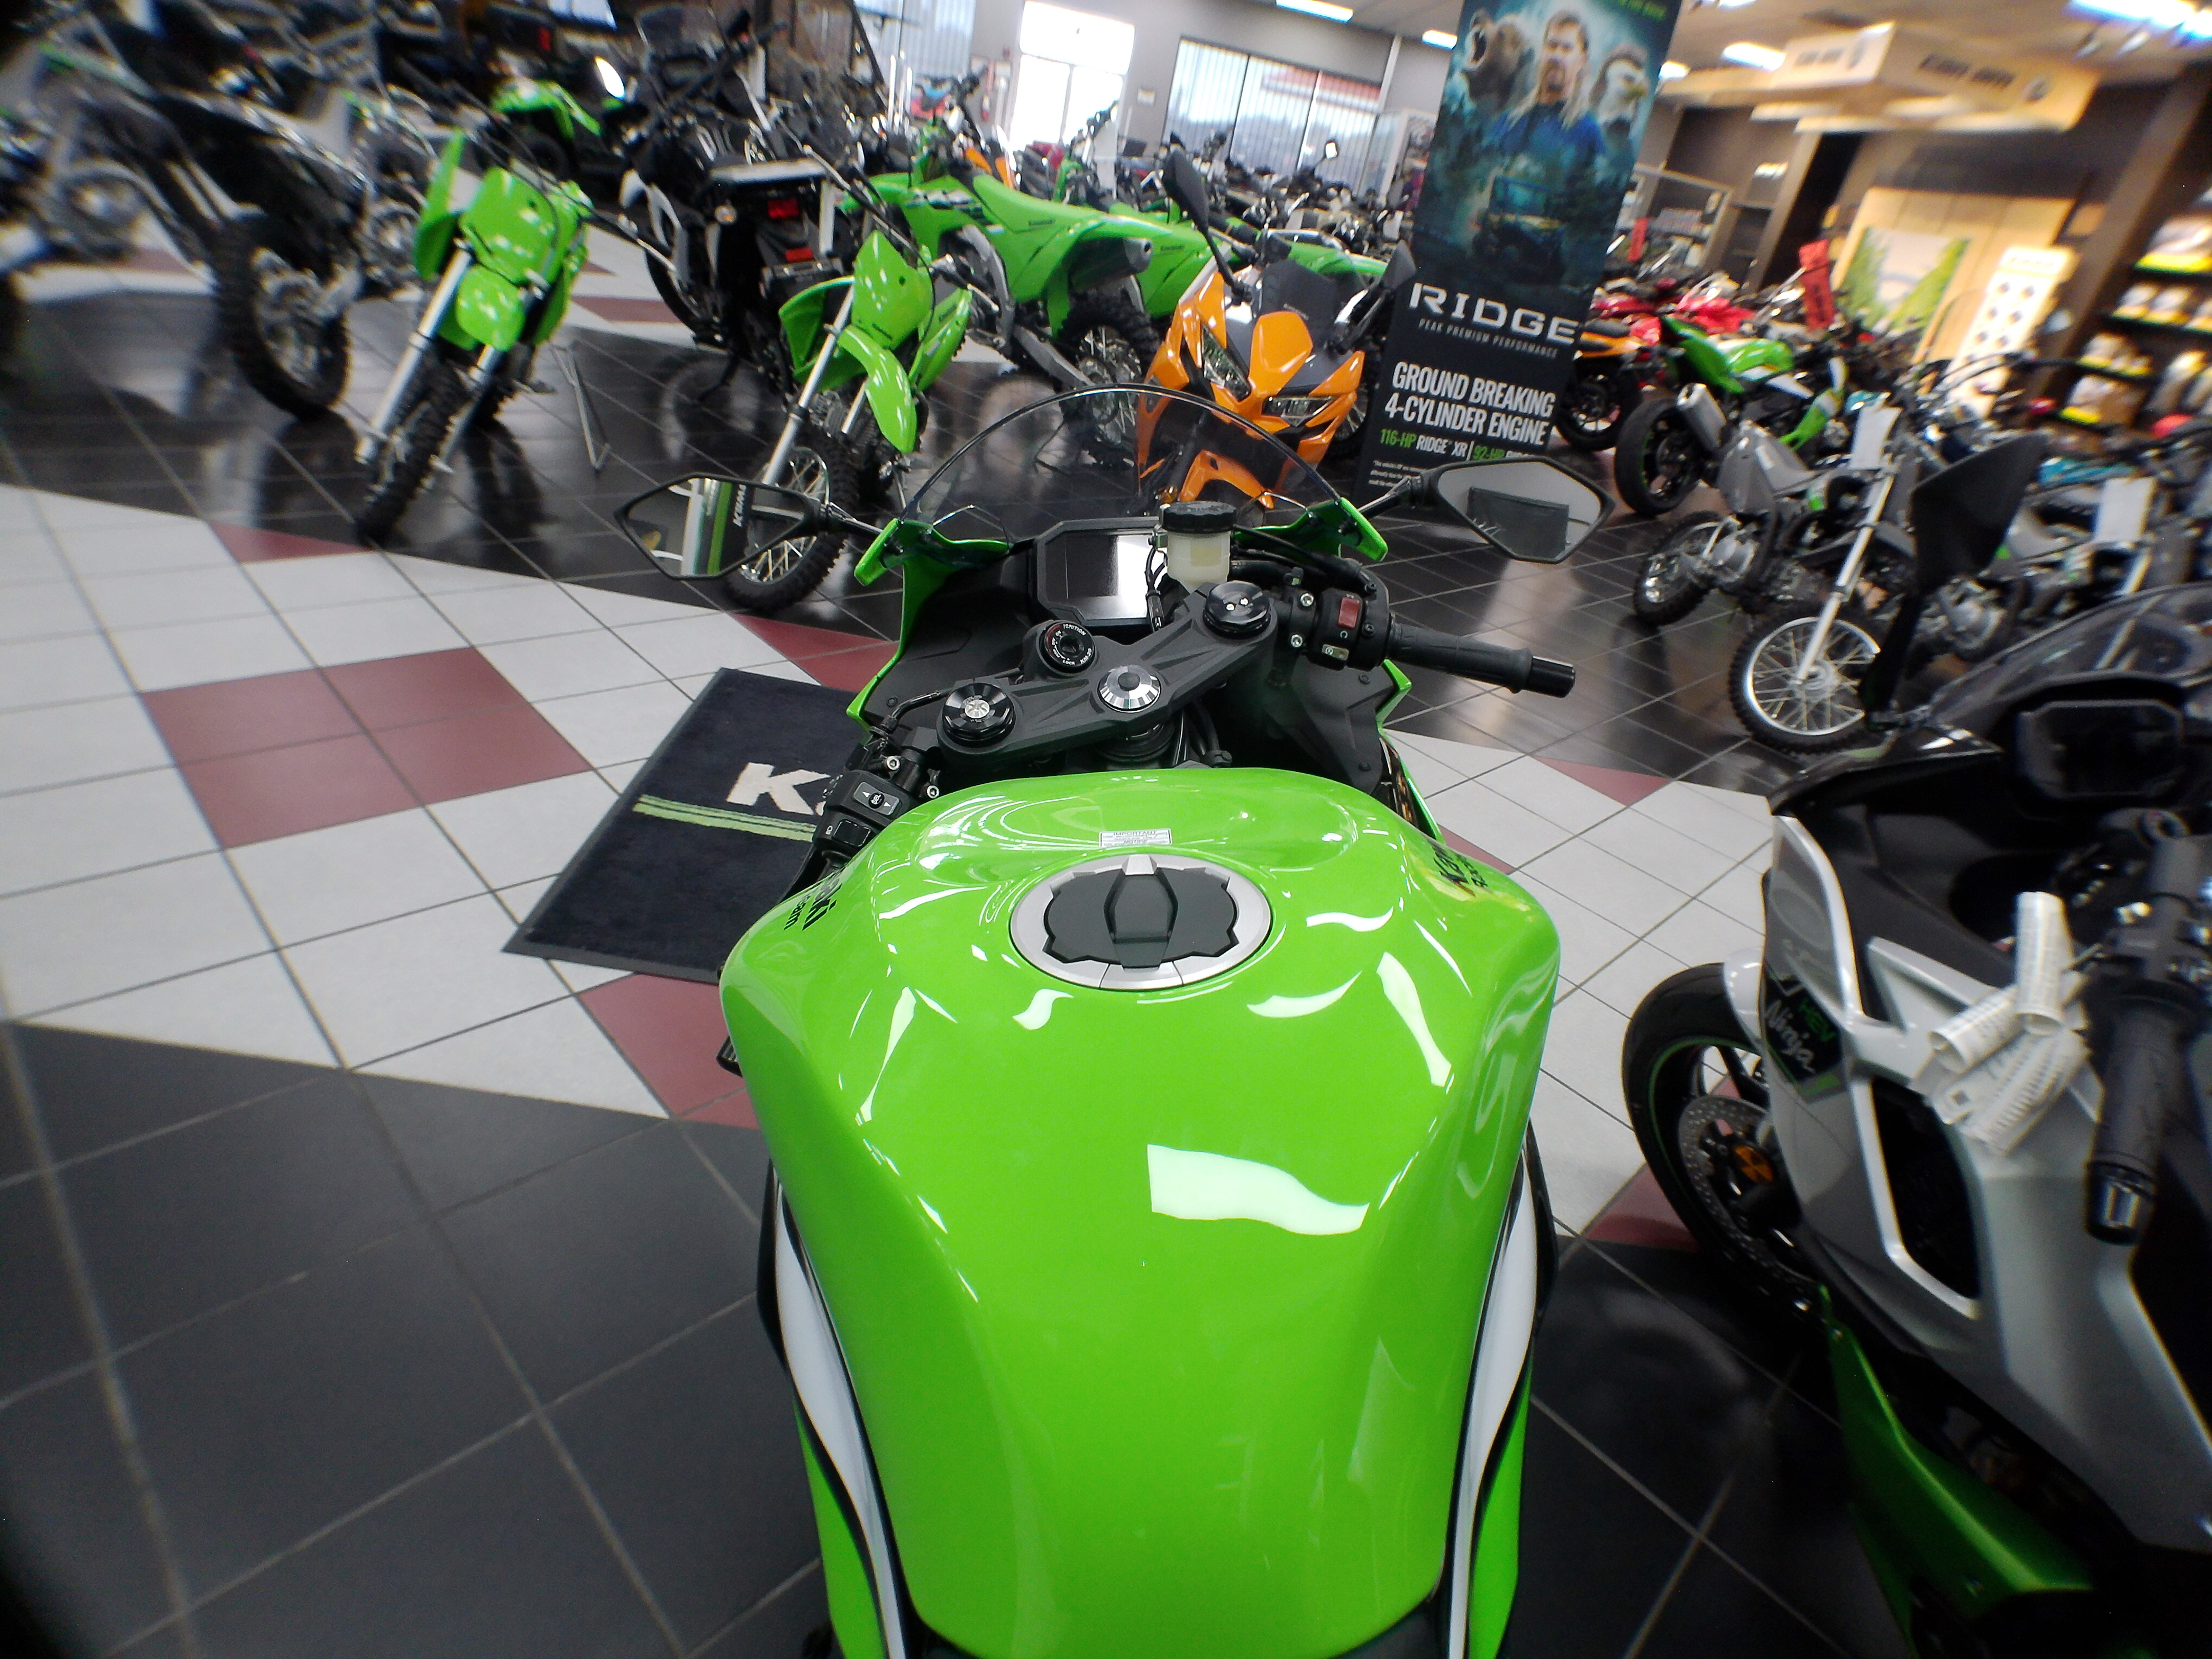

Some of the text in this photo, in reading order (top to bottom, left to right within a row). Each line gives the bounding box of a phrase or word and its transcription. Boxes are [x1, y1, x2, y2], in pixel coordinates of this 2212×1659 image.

[1409, 282, 1579, 345] RIDGE
[1418, 318, 1559, 358] PEAK PREMIUM PERFORMANCE
[1392, 361, 1557, 418] GROUND BREAKING
[1380, 429, 1417, 448] 116-HP
[1473, 445, 1505, 460] 92-HP
[1385, 392, 1549, 445] 4-CYLINDER ENGINE
[1063, 624, 1087, 635] IGNITION
[1764, 999, 1816, 1074] Ninja
